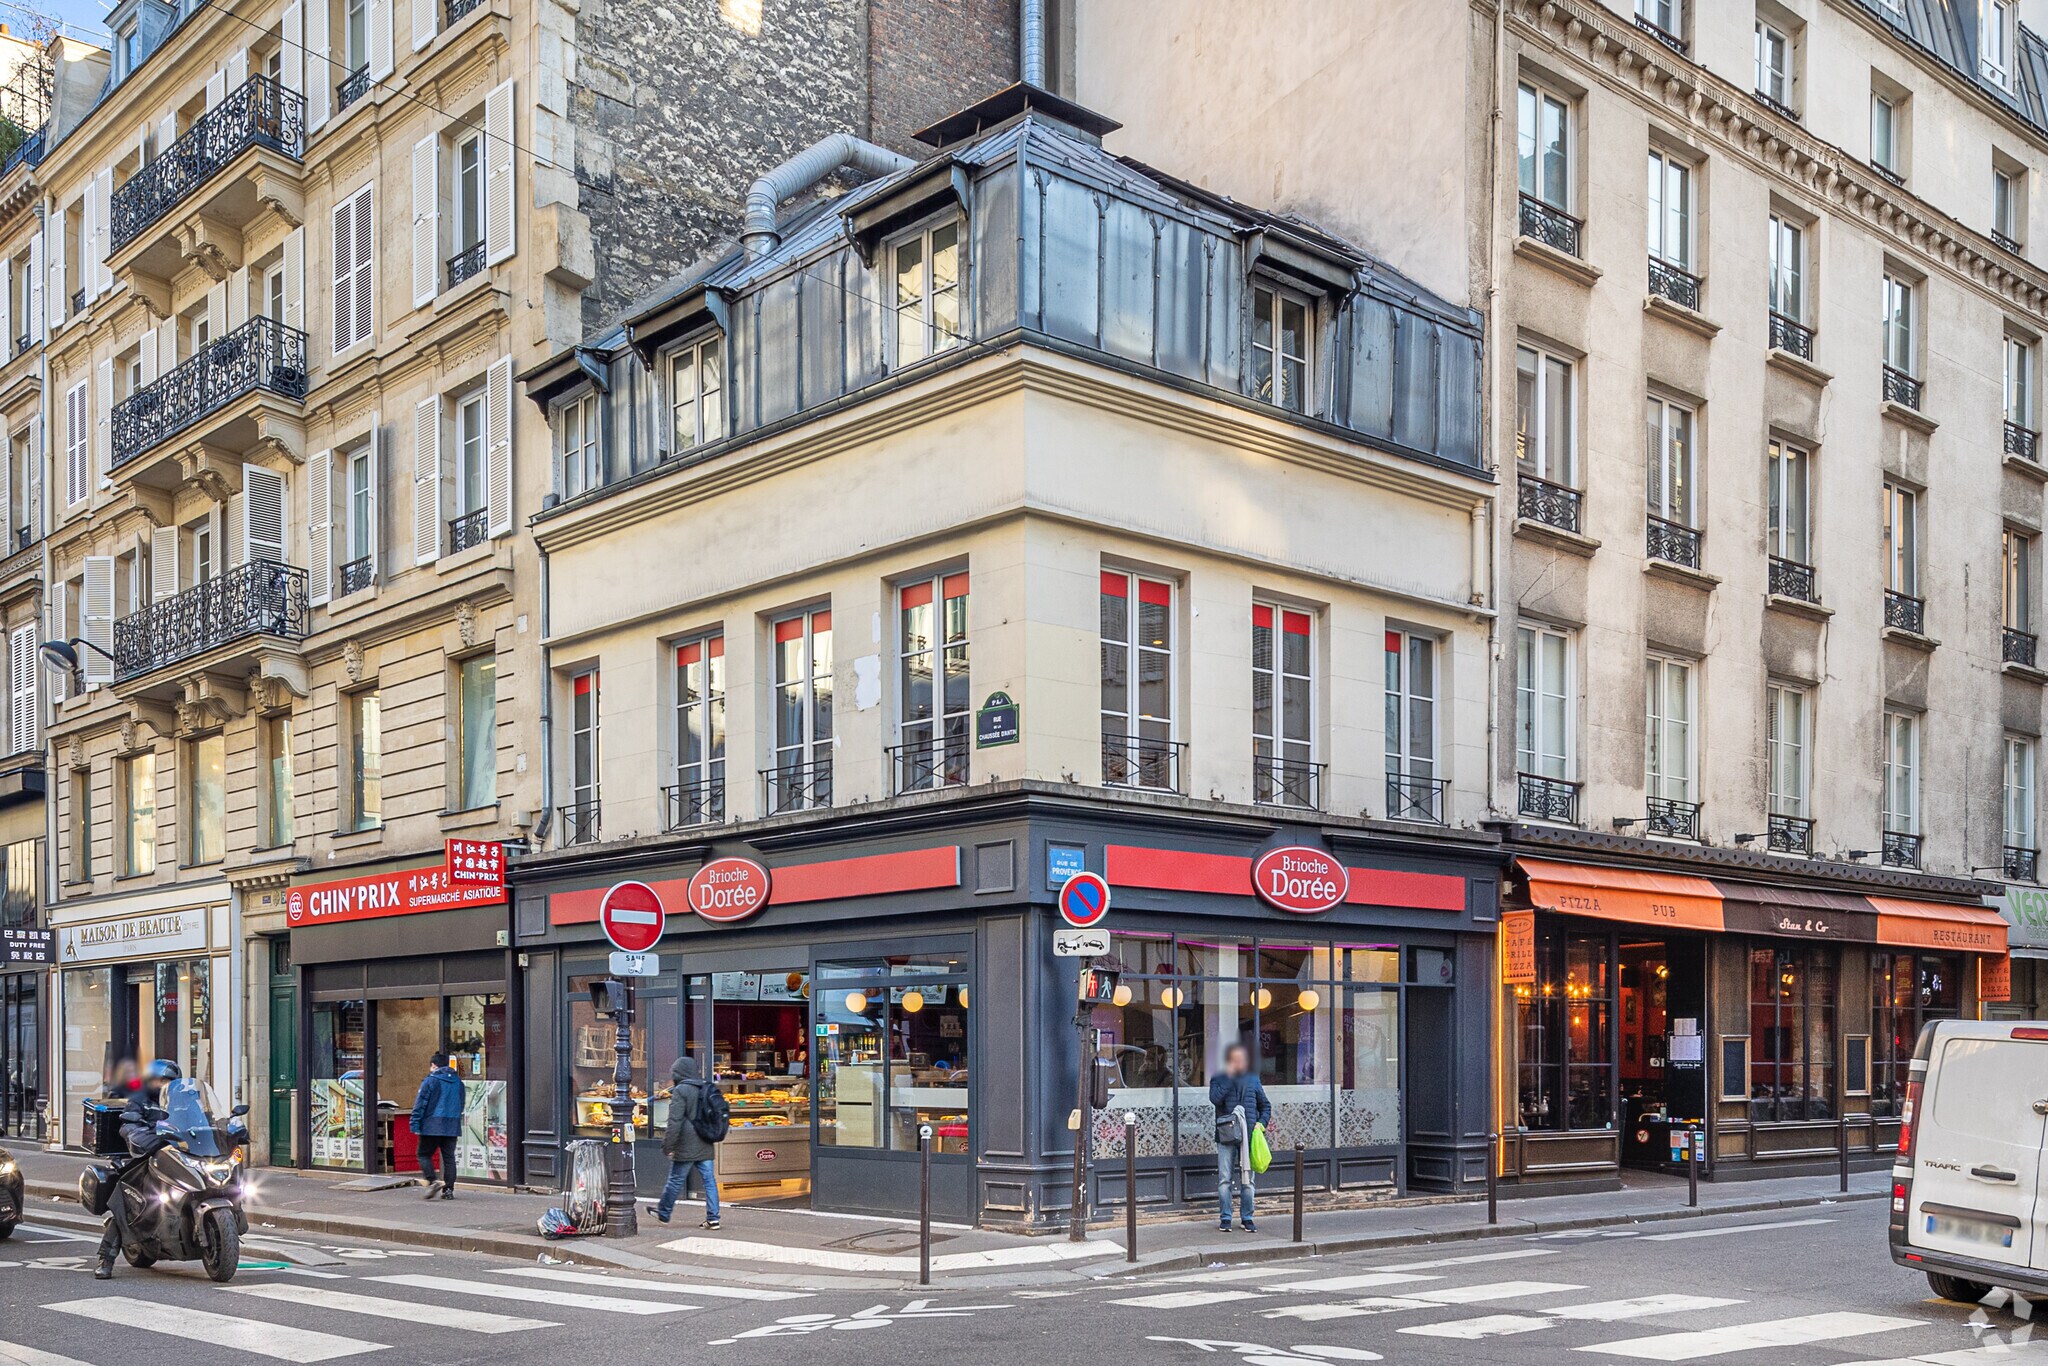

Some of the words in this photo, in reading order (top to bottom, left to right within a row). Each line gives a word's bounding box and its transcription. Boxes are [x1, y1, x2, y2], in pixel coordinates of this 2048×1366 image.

[1282, 855, 1328, 875] Brioche
[454, 870, 499, 881] CHIN'PRIX
[709, 867, 749, 884] Brioche
[1271, 869, 1336, 900] Dorée
[310, 881, 400, 916] CHIN'PRIX
[409, 890, 460, 907] SUPERMARCHÉ
[463, 886, 501, 900] ASIATIQUE
[700, 884, 756, 909] Dorée
[1560, 896, 1601, 911] PIZZA
[1652, 904, 1676, 917] PUB
[81, 924, 118, 944] MAISON
[122, 922, 136, 939] DE
[1780, 918, 1801, 930] Stan
[1805, 920, 1812, 931] &
[1816, 921, 1829, 932] Co
[1933, 930, 1991, 944] RESTAURANT
[1924, 1160, 1961, 1171] TRAFIC
